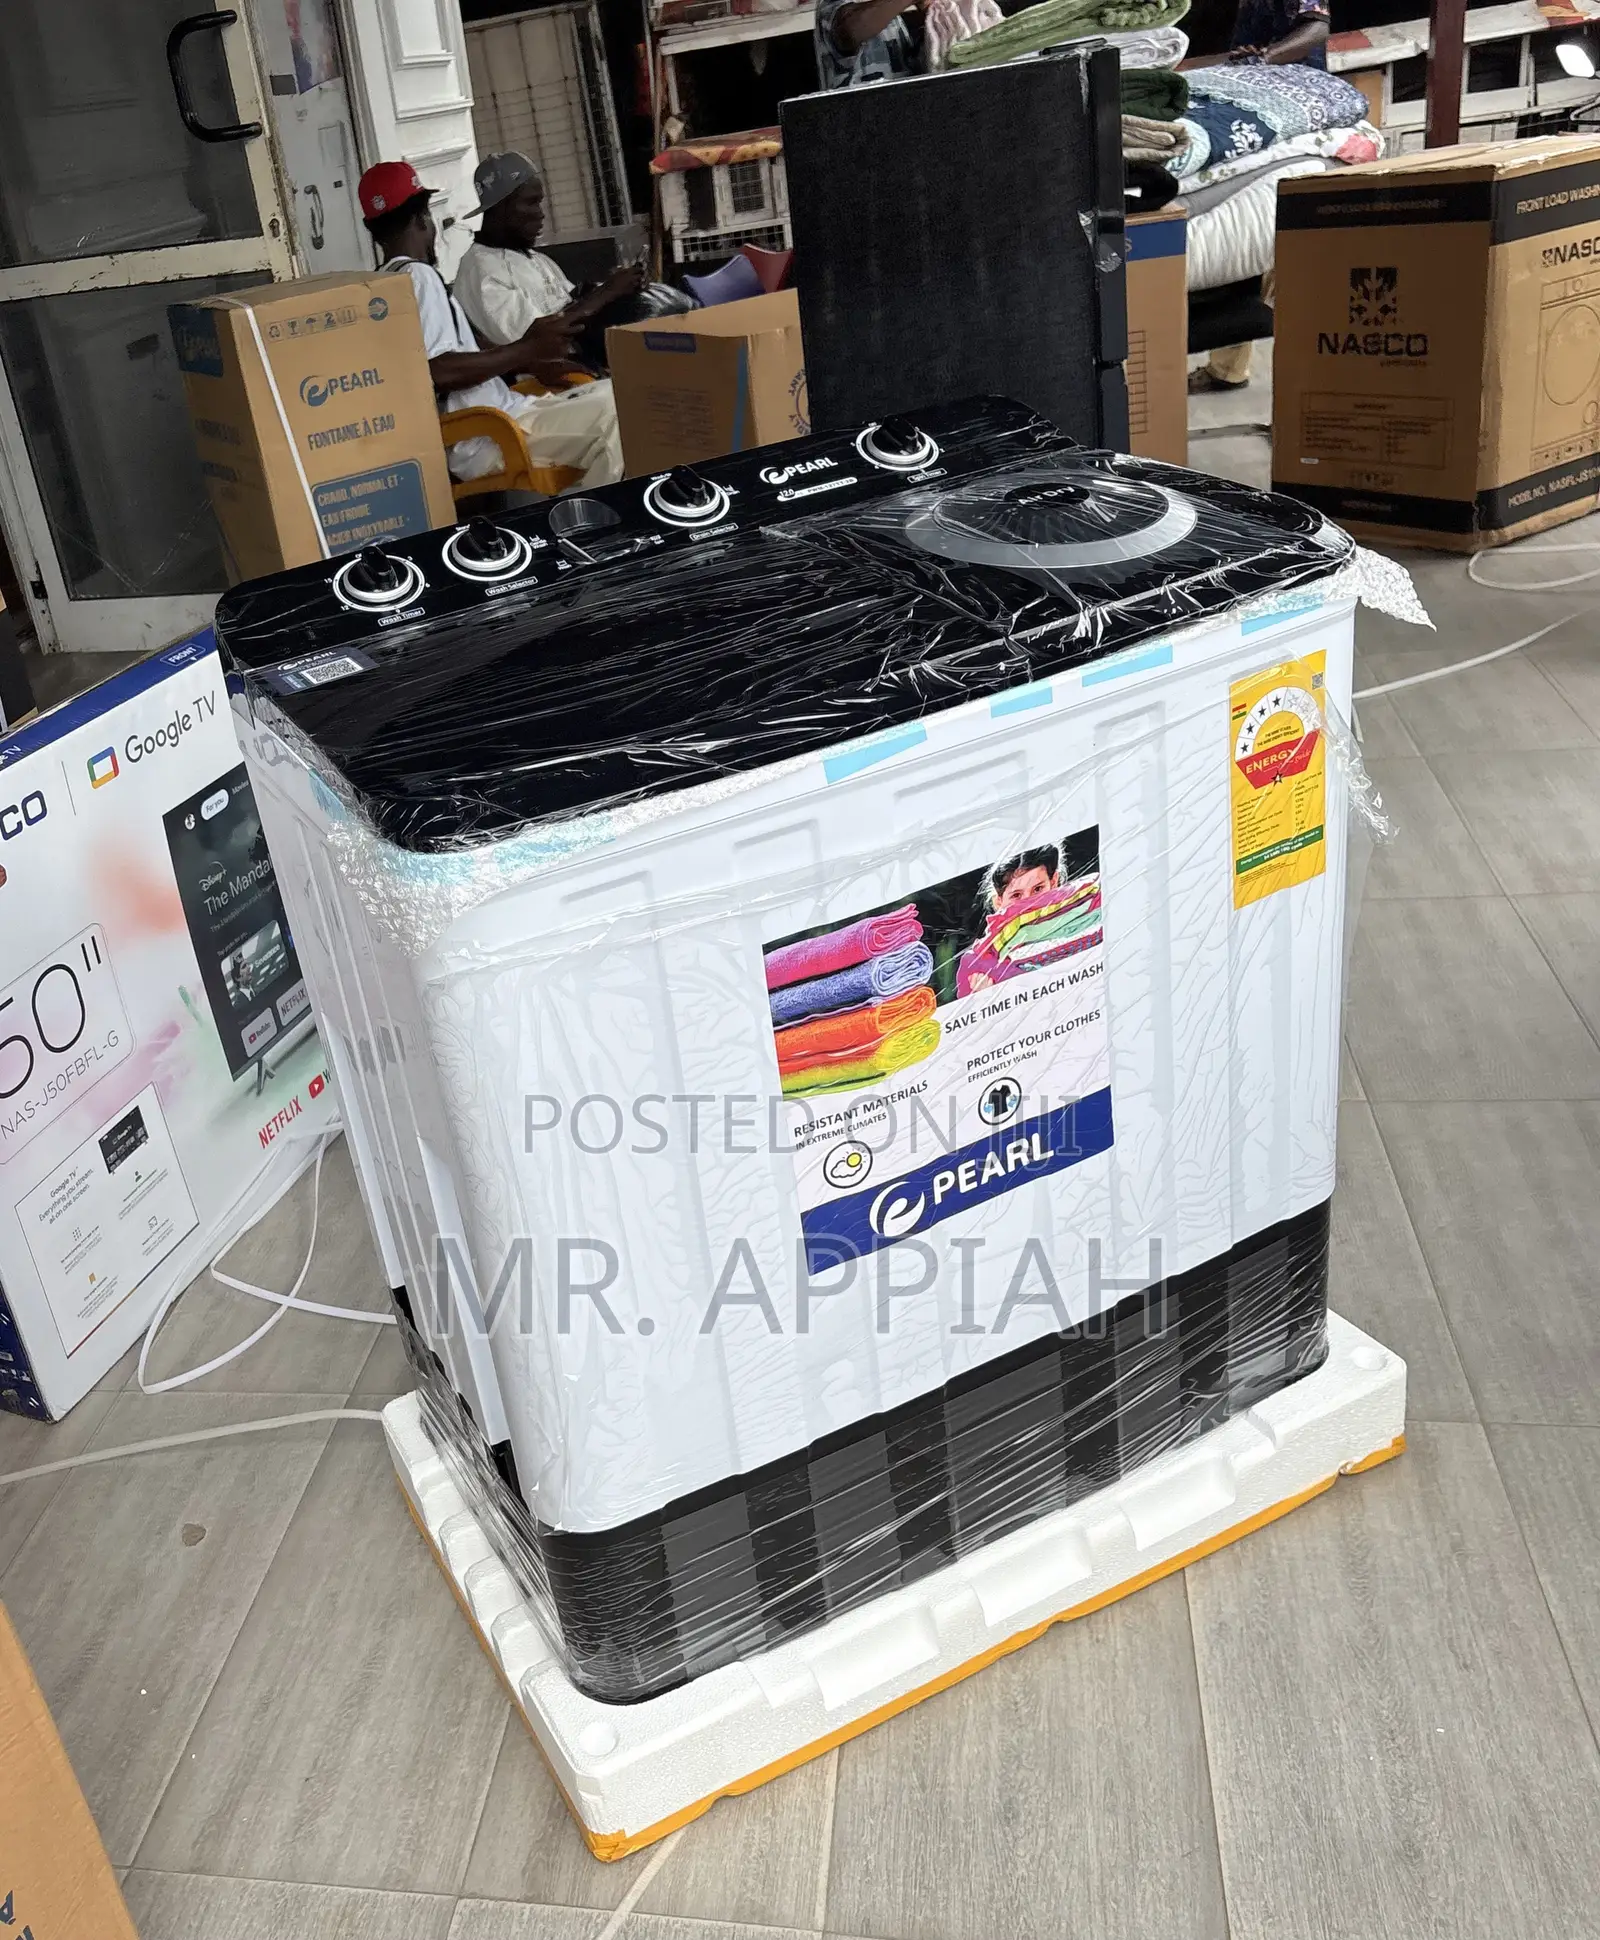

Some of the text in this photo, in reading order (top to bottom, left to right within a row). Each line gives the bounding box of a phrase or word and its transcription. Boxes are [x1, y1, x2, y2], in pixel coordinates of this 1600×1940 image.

[1544, 191, 1568, 208] LOAD
[1317, 332, 1429, 357] NASCO
[329, 368, 384, 396] PEARL
[308, 422, 363, 450] FONTAINE
[372, 413, 396, 431] EAU
[785, 456, 838, 477] PEARL
[350, 478, 388, 498] NORMAL
[387, 474, 398, 488] ET
[1018, 486, 1075, 505] Air Dry
[321, 511, 340, 528] EAU
[488, 579, 534, 595] Wash Selector
[381, 610, 422, 624] Wash Timer
[168, 646, 197, 664] FRONT
[125, 690, 216, 763] Google TV
[1245, 749, 1294, 774] ENERGY
[231, 780, 250, 796] Movies
[205, 797, 225, 814] For you
[204, 891, 229, 916] The
[255, 943, 281, 968] Severance
[281, 986, 306, 1018] NETFLIX
[945, 962, 1104, 1034] SAVE TIME IN EACH WASH
[967, 1009, 1101, 1071] PROTECT YOUR CLOTHES
[967, 1049, 1037, 1083] EFFICIENTLY WASH
[1, 1029, 119, 1140] NAS-J50FBFL-G
[794, 1079, 928, 1138] RESISTANT MATERIALS
[258, 1095, 303, 1149] NETFLIX
[795, 1112, 887, 1151] IN EXTREME CLIMATES
[933, 1131, 1054, 1206] PEARL
[50, 1179, 69, 1198] Google
[39, 1194, 67, 1222] Everything
[66, 1185, 76, 1199] you
[55, 1209, 63, 1218] on
[62, 1200, 72, 1211] one
